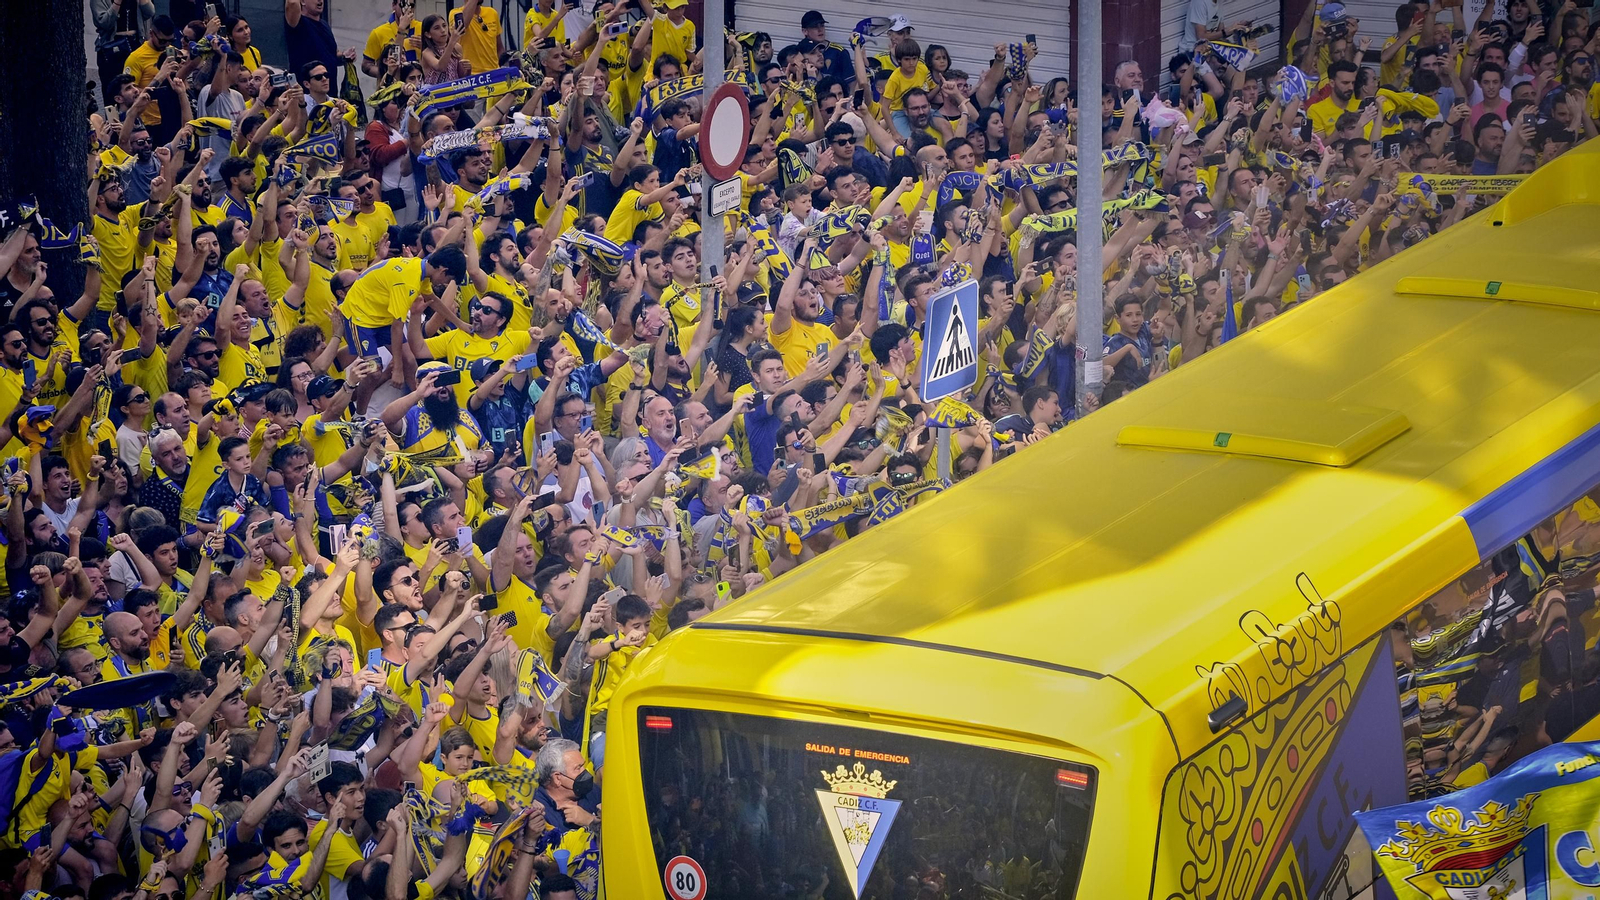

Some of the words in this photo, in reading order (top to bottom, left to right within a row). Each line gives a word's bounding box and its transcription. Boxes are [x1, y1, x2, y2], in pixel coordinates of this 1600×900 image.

[451, 78, 477, 91] CADIZ
[1491, 179, 1523, 187] LIBERT
[805, 743, 836, 755] SALIDA
[839, 747, 851, 757] DE
[854, 749, 910, 765] EMERGENCIA
[837, 796, 862, 808] CADIZ
[865, 799, 879, 811] C.F.
[676, 871, 696, 892] 80
[1435, 865, 1496, 887] CADIZ
